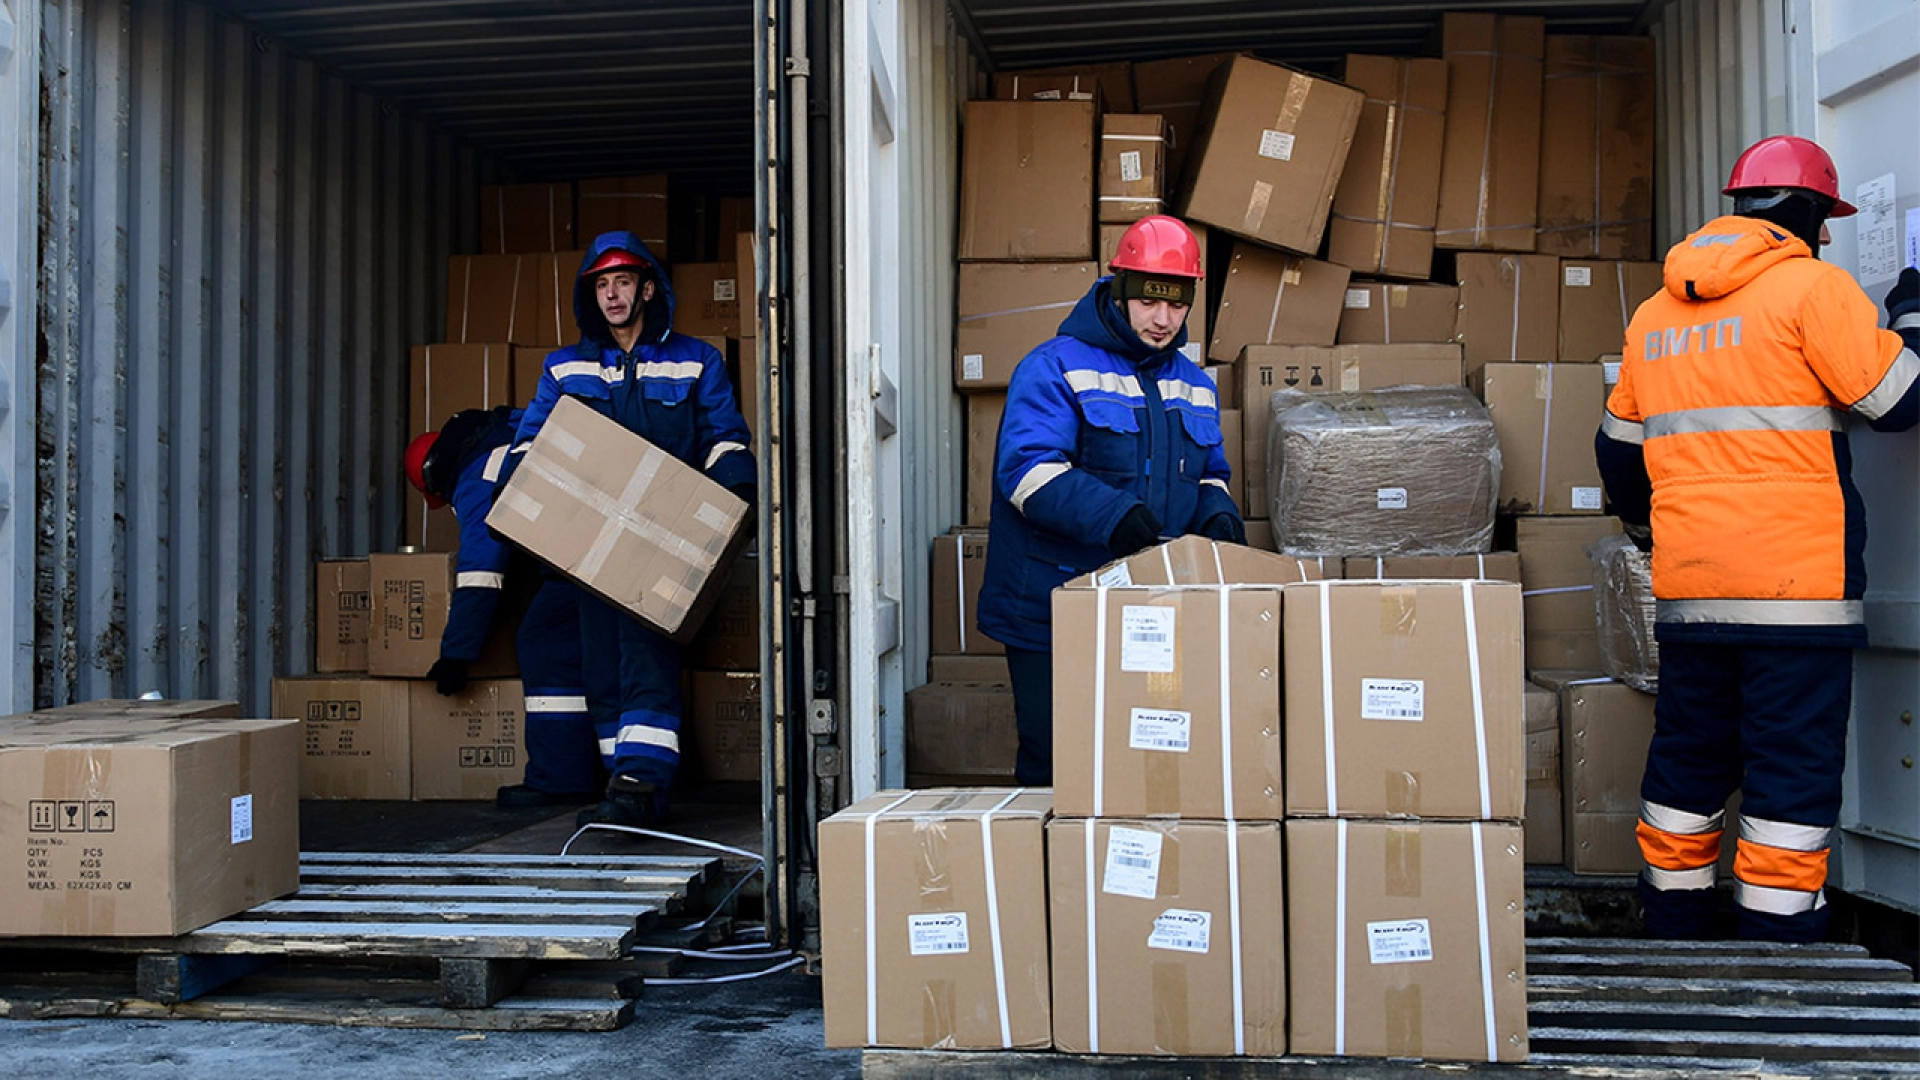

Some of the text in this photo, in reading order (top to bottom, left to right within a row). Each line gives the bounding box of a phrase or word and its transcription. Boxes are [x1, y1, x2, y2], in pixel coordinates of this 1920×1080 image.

[1645, 316, 1742, 362] ВМТП
[83, 848, 103, 857] PCS
[80, 859, 101, 868] KGS
[80, 870, 101, 879] KGS
[116, 881, 132, 891] CM
